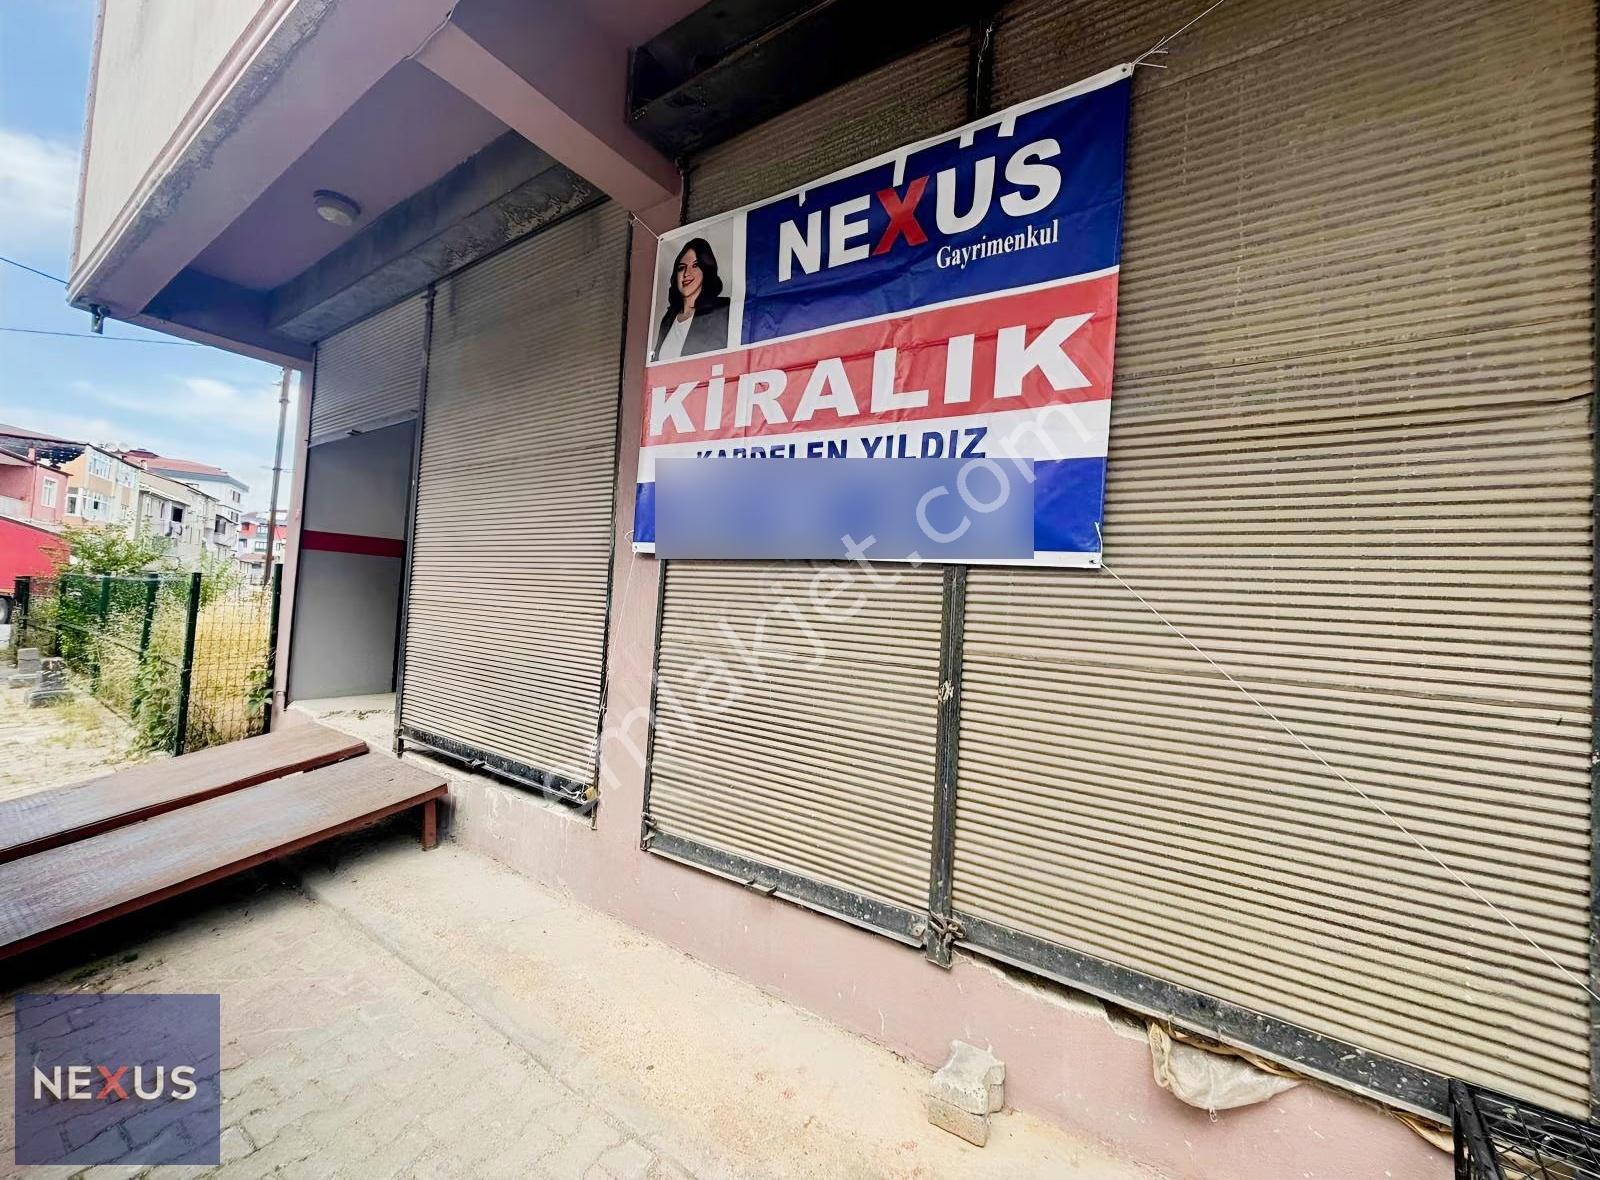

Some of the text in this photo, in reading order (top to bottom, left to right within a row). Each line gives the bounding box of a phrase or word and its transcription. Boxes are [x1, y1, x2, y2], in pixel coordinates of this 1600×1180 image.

[778, 137, 1063, 283] NEXUS
[935, 219, 1060, 270] Gayrimenkul
[649, 312, 1097, 437] KİRALIK
[696, 426, 988, 458] ELEN YILDIZ
